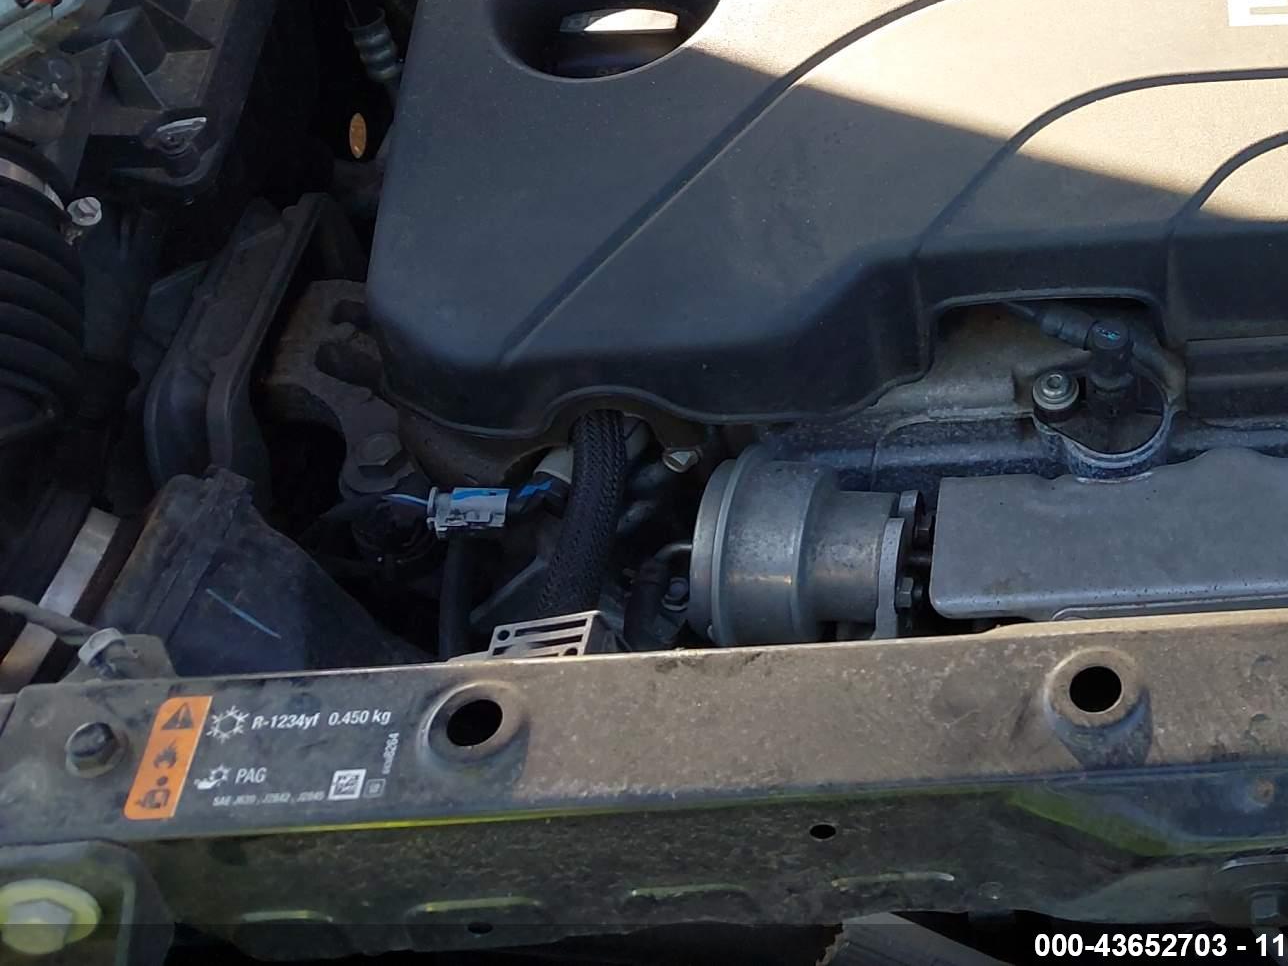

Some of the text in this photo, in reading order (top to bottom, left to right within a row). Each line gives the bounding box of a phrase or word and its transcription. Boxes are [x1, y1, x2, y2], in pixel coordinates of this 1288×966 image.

[251, 709, 393, 731] R-1234yf 0.450 kg
[234, 767, 267, 785] PAG
